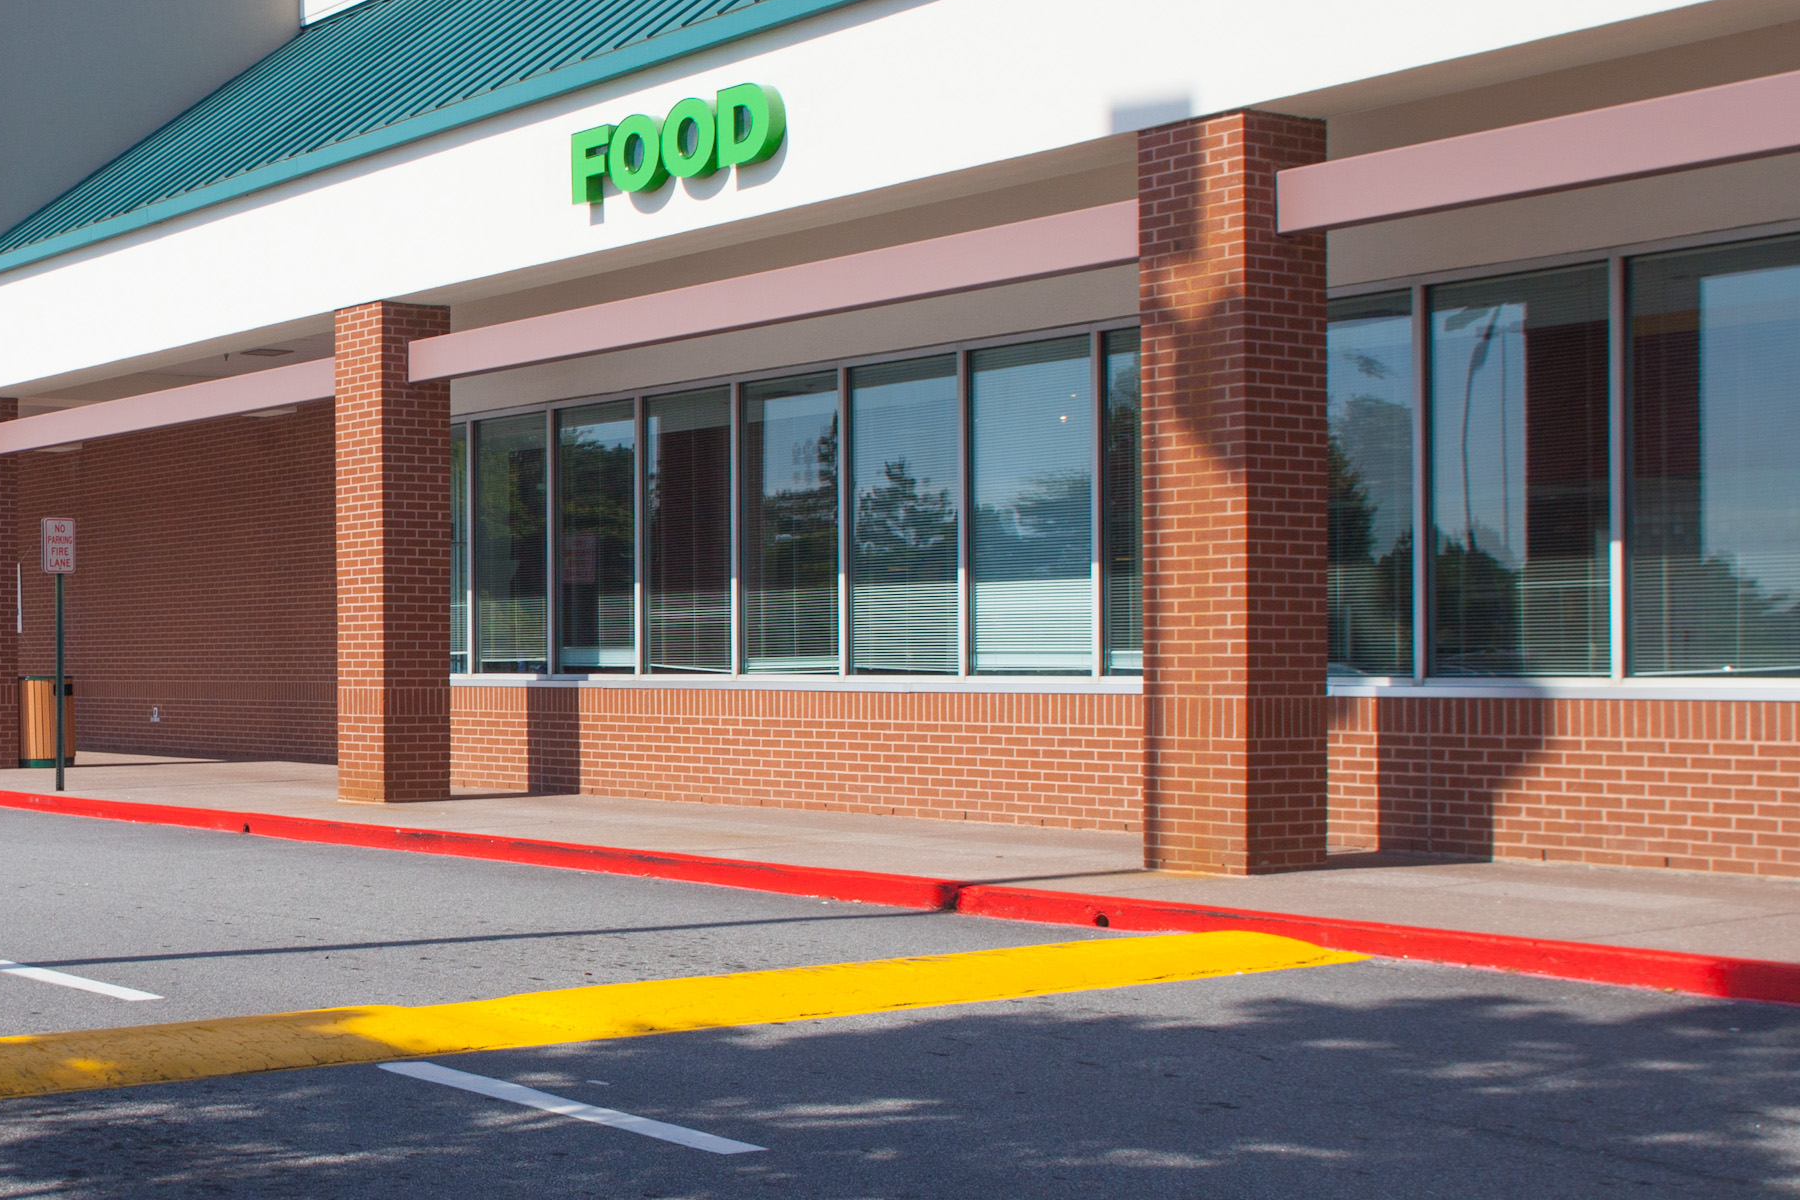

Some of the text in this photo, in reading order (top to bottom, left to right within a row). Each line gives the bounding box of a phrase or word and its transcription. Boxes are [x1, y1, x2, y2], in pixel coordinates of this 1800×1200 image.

[570, 82, 787, 206] FOOD
[54, 524, 66, 533] NO
[47, 535, 73, 545] PARKING
[51, 546, 69, 556] FIRE
[49, 558, 71, 568] LANE
